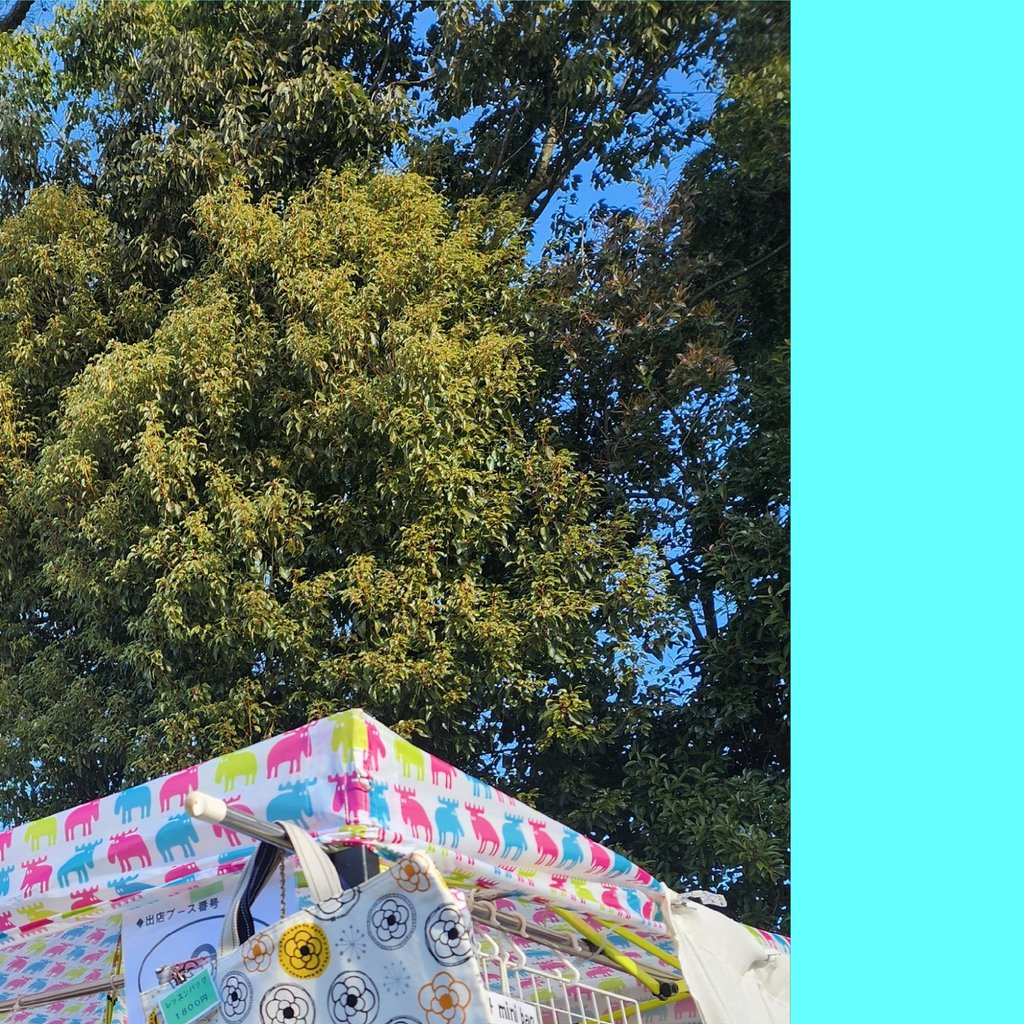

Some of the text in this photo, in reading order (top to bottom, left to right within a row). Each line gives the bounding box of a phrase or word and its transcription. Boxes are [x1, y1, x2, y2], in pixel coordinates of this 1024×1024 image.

[145, 898, 220, 926] 出店ブース番号
[175, 993, 209, 1020] 1800円
[498, 1001, 519, 1023] mini
